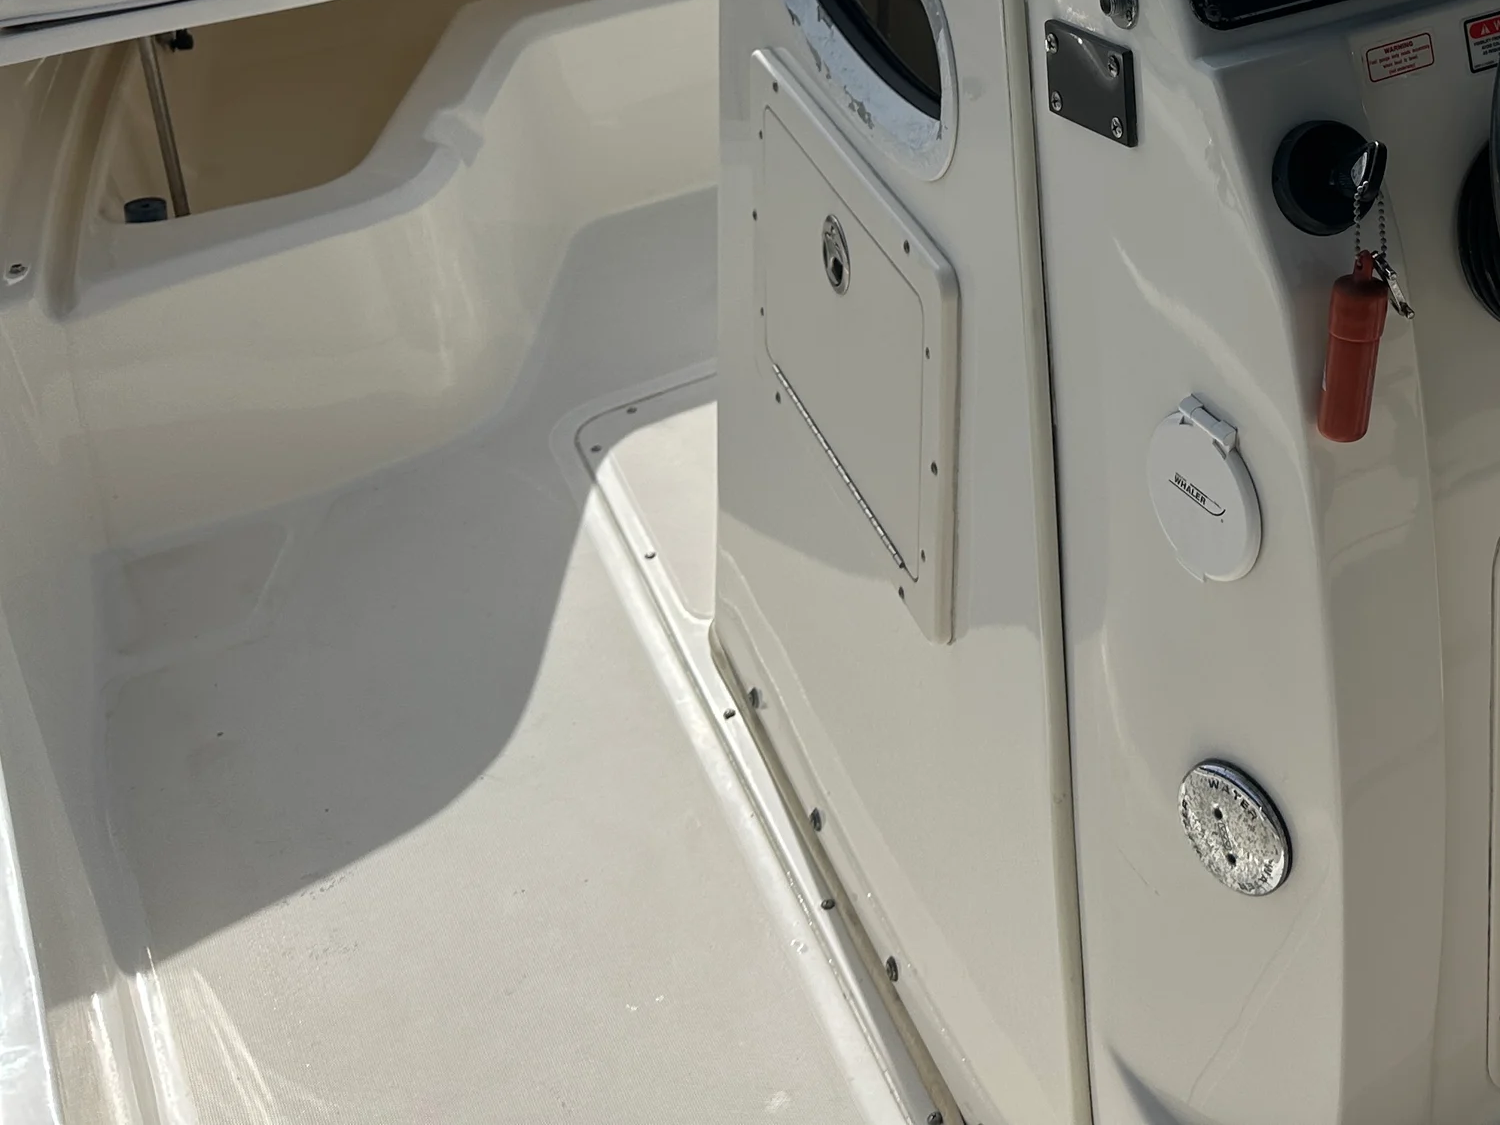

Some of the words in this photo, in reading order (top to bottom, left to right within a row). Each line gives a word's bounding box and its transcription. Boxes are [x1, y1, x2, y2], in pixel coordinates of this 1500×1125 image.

[1384, 40, 1414, 54] WARNING
[1174, 474, 1206, 506] WHALER
[1209, 778, 1258, 820] WATER
